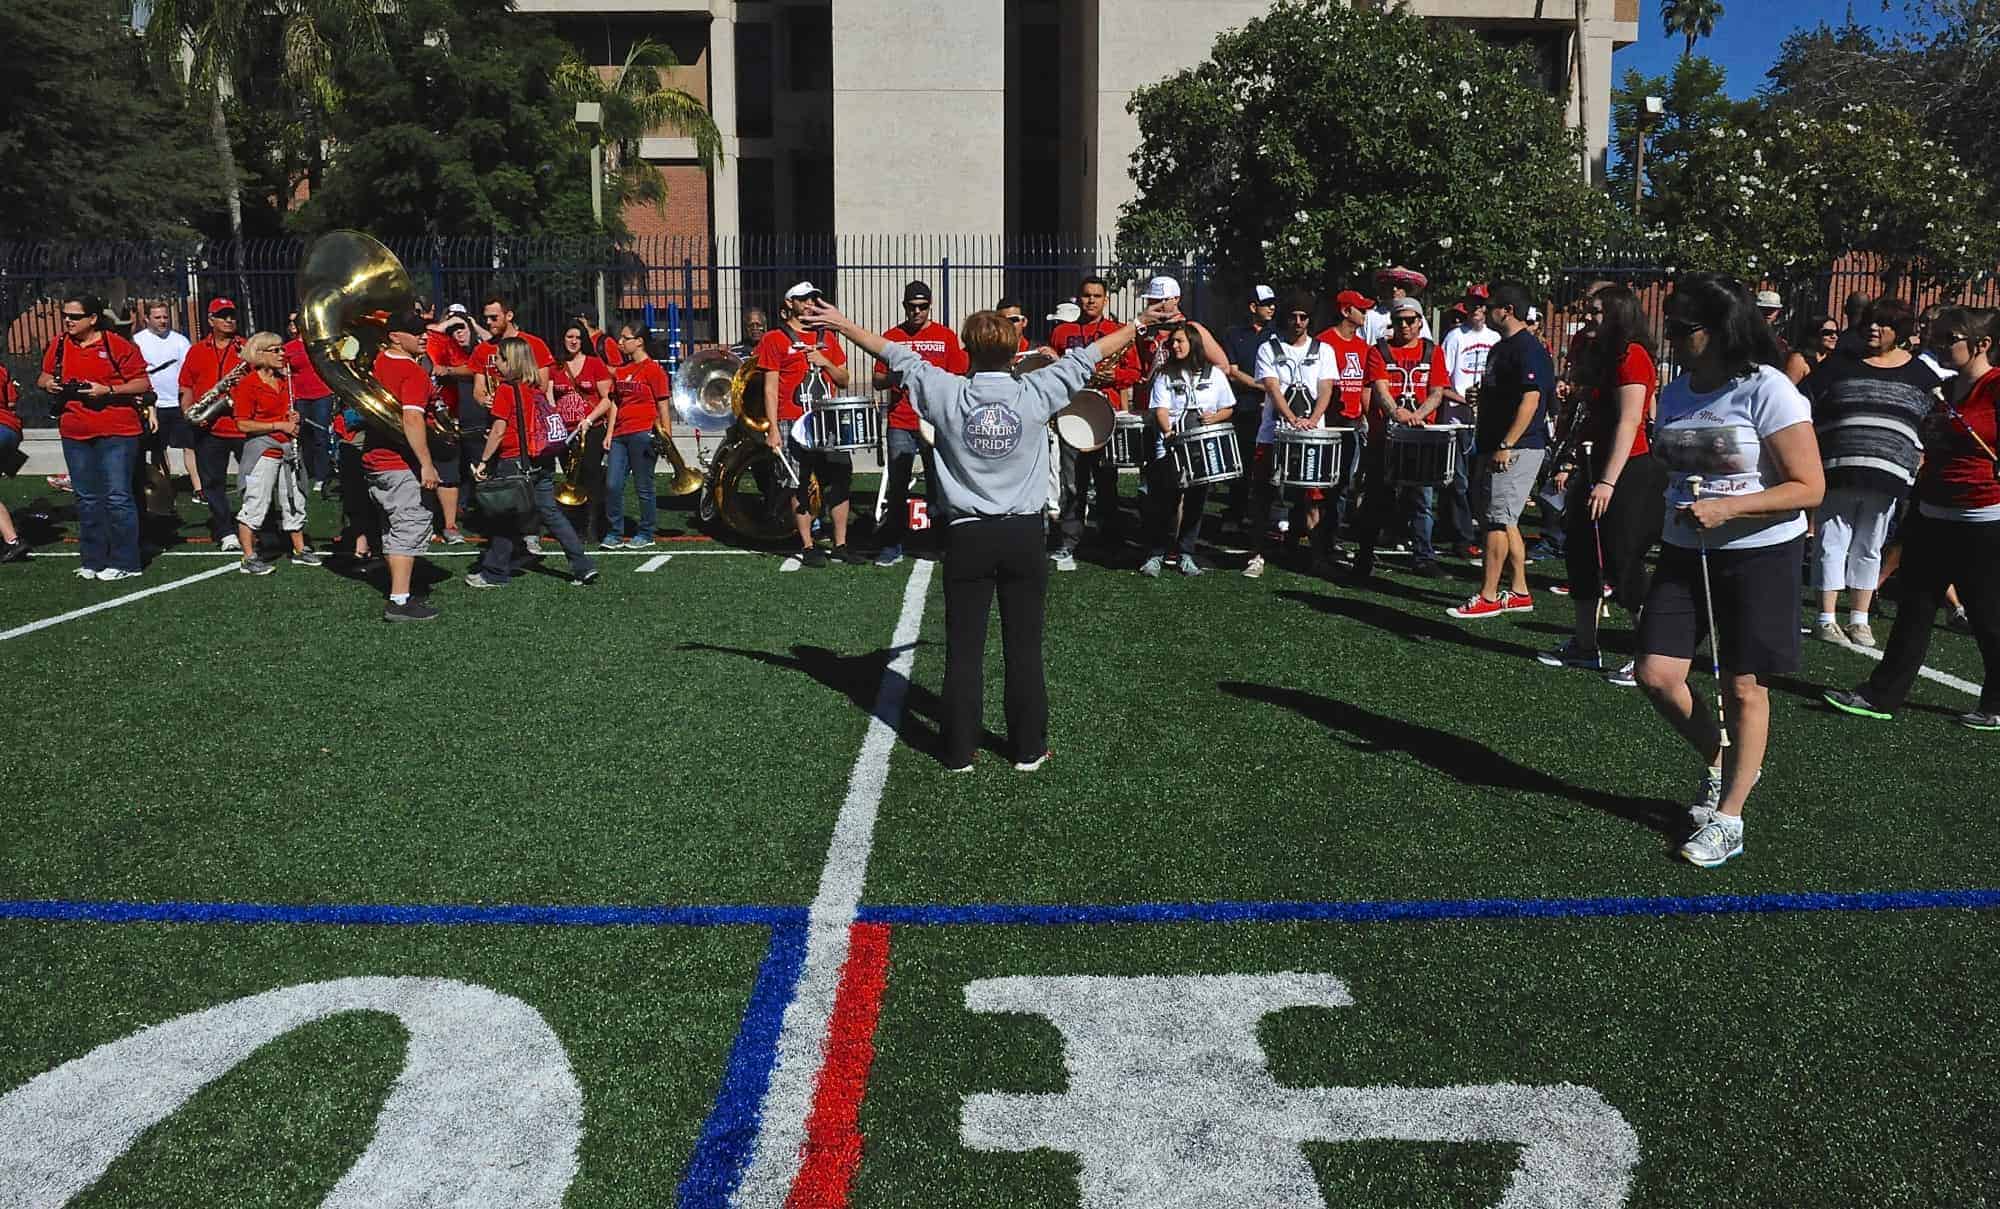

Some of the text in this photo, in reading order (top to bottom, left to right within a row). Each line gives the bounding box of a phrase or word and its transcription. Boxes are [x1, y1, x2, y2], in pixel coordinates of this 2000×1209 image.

[915, 343, 945, 352] TOUGH
[1341, 352, 1364, 379] A
[547, 414, 568, 441] A
[967, 424, 1018, 436] CENTURY
[974, 438, 1012, 450] PRIDE
[912, 502, 931, 530] 5
